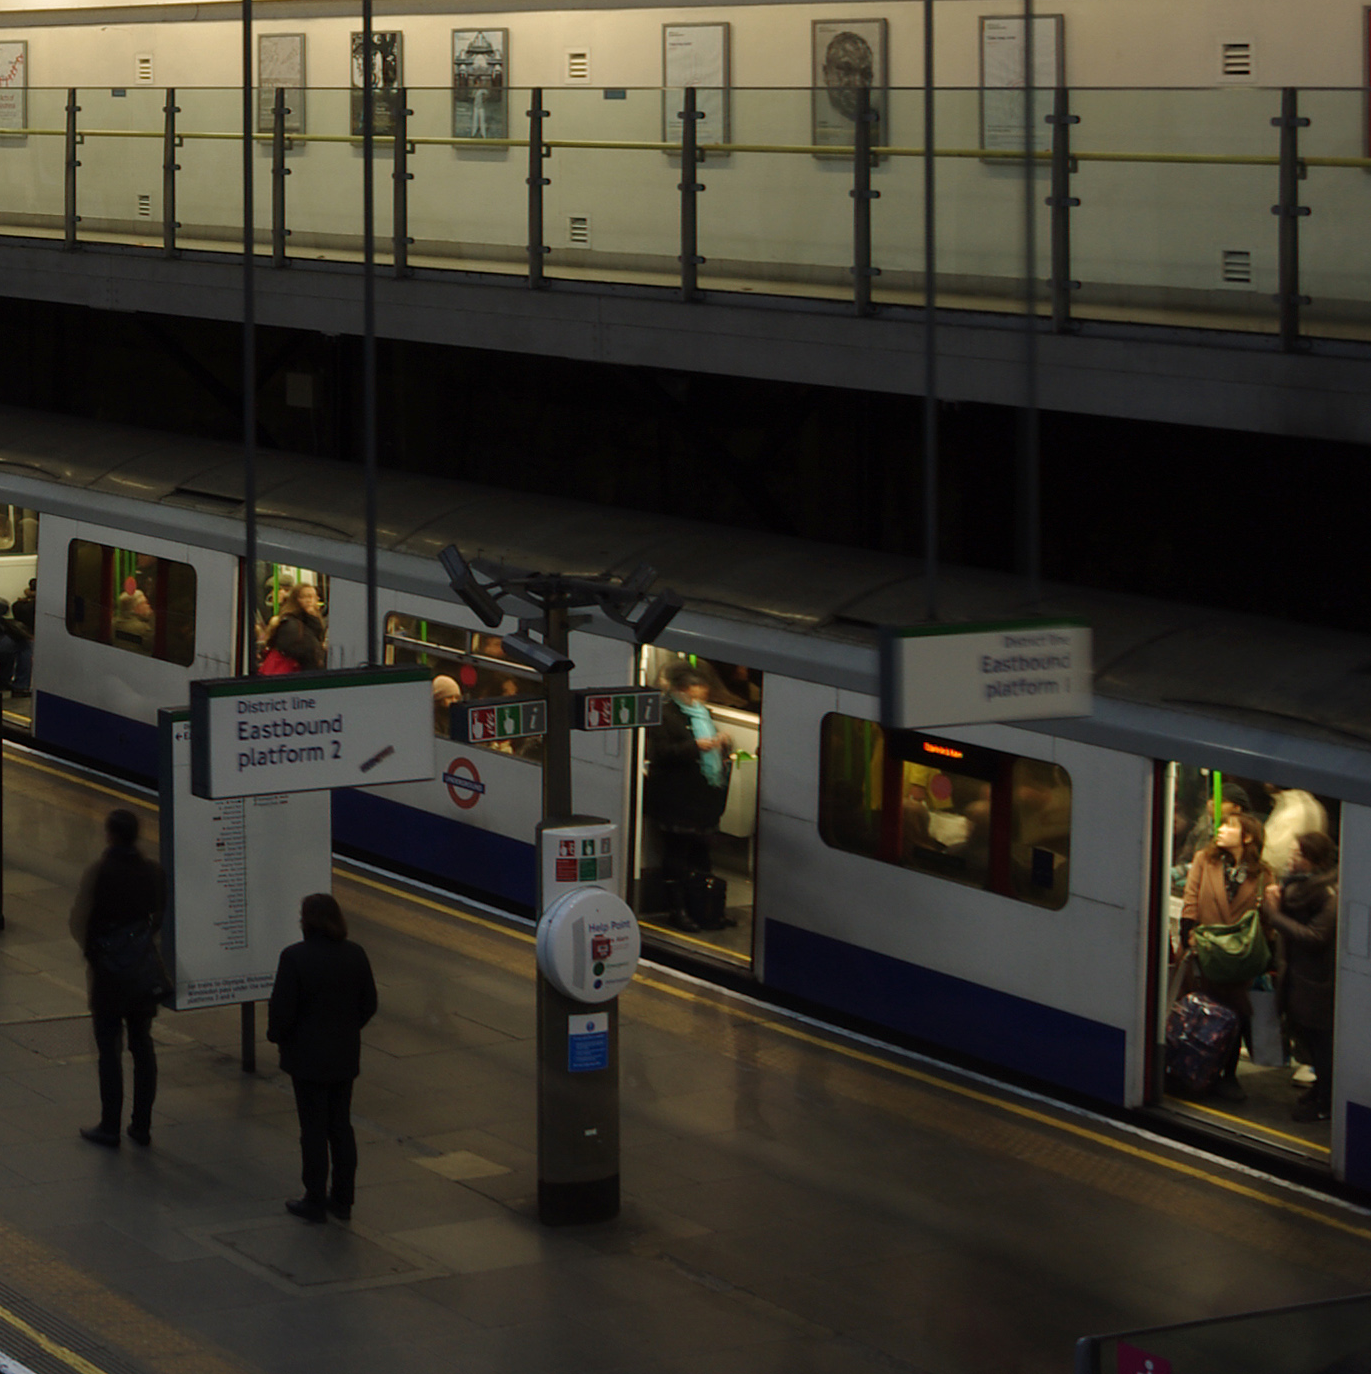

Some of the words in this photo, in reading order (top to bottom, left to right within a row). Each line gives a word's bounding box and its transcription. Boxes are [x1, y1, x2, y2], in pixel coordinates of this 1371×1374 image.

[982, 653, 1070, 674] Eastbound
[986, 678, 1060, 703] platform
[237, 699, 287, 714] District
[292, 697, 316, 709] line
[238, 715, 343, 741] Eastbound
[238, 744, 325, 772] platform
[331, 741, 342, 759] 2
[589, 923, 608, 933] Help
[611, 920, 631, 929] Point
